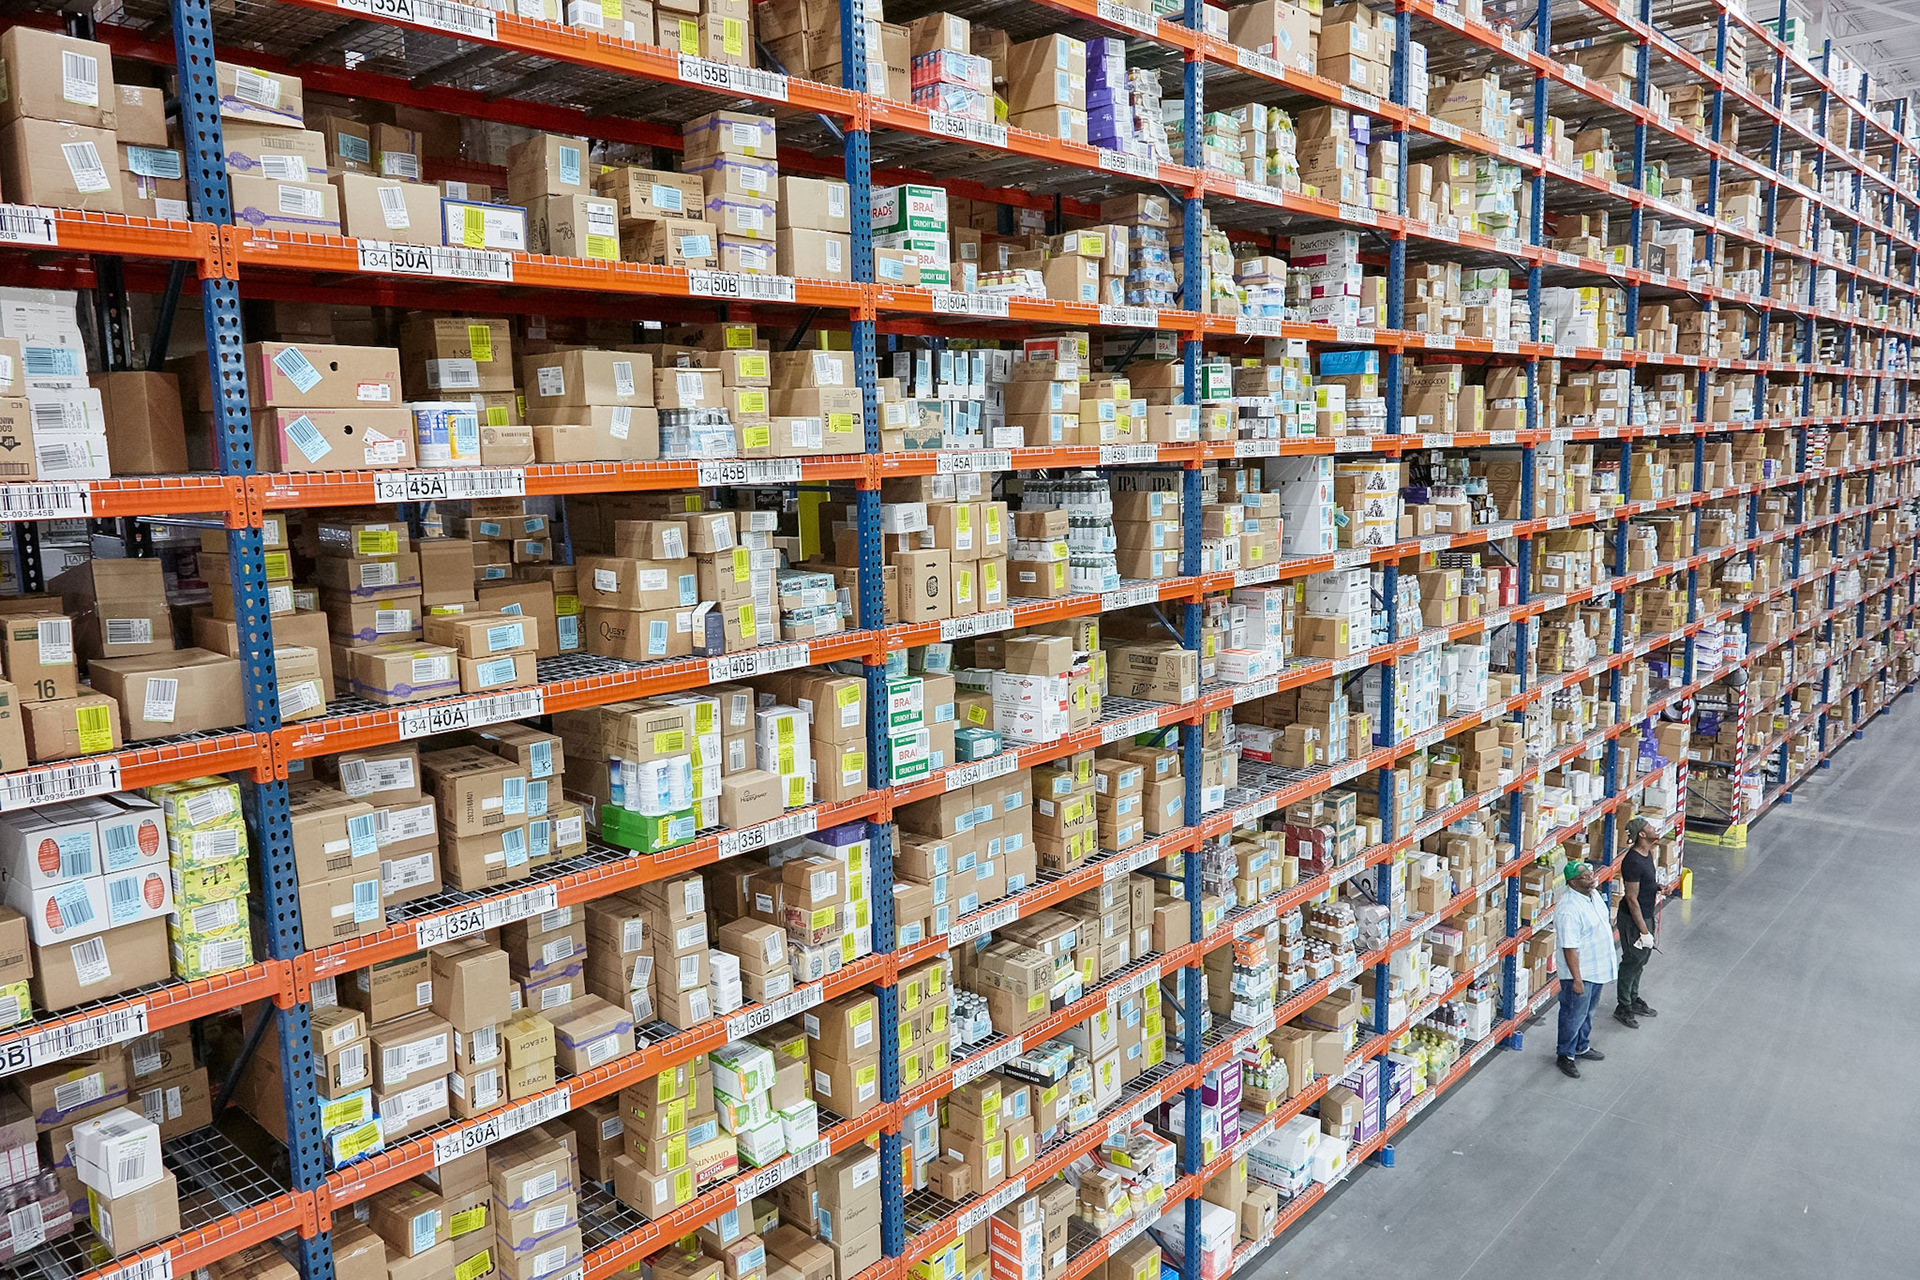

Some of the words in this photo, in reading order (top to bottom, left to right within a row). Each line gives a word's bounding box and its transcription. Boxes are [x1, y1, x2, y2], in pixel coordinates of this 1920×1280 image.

[373, 0, 411, 17] 55A
[630, 9, 649, 18] method
[686, 65, 699, 79] 34
[703, 65, 728, 84] 55B
[935, 118, 945, 132] 32
[947, 116, 965, 136] 55A
[1112, 154, 1126, 171] 55B
[369, 253, 388, 267] 34
[395, 250, 430, 270] 50A
[696, 279, 709, 292] 34
[714, 278, 737, 294] 50B
[937, 300, 948, 311] 32
[950, 295, 968, 311] 50A
[1113, 308, 1126, 322] 50B
[398, 429, 408, 437] #7
[1113, 447, 1126, 461] 45B
[941, 461, 952, 472] 32
[954, 455, 971, 470] 45A
[705, 470, 718, 483] 34
[722, 465, 745, 481] 45B
[1118, 475, 1137, 491] IPA
[1153, 475, 1171, 491] IPA
[385, 484, 404, 498] 34
[410, 477, 444, 496] 45A
[1078, 508, 1093, 516] Things
[1079, 544, 1097, 552] Things
[944, 626, 955, 638] 32
[957, 621, 974, 636] 40A
[715, 667, 729, 680] 34
[732, 657, 755, 674] 40B
[33, 678, 56, 700] 16
[410, 718, 427, 734] 34
[433, 706, 466, 729] 40A
[949, 774, 960, 788] 32
[963, 767, 980, 784] 35A
[29, 789, 86, 805] A5-0936-40B
[1063, 815, 1085, 830] KIND
[725, 840, 738, 855] 34
[742, 830, 764, 848] 35B
[427, 927, 444, 943] 34
[450, 911, 481, 935] 35A
[963, 922, 980, 940] 30A
[924, 982, 946, 999] KD
[900, 995, 922, 1013] KD
[733, 1020, 746, 1036] 34
[749, 1008, 771, 1028] 30B
[58, 1036, 113, 1057] A5-0936-35B
[900, 1069, 923, 1087] KD
[968, 1062, 985, 1079] 25A
[527, 1074, 547, 1086] EACH
[444, 1141, 461, 1158] 34
[466, 1121, 497, 1149] 30A
[695, 1150, 729, 1168] SUN-MAID
[699, 1162, 724, 1181] RAISINS
[742, 1186, 755, 1200] 34
[757, 1167, 780, 1191] 25B
[993, 1226, 1017, 1248] Banza
